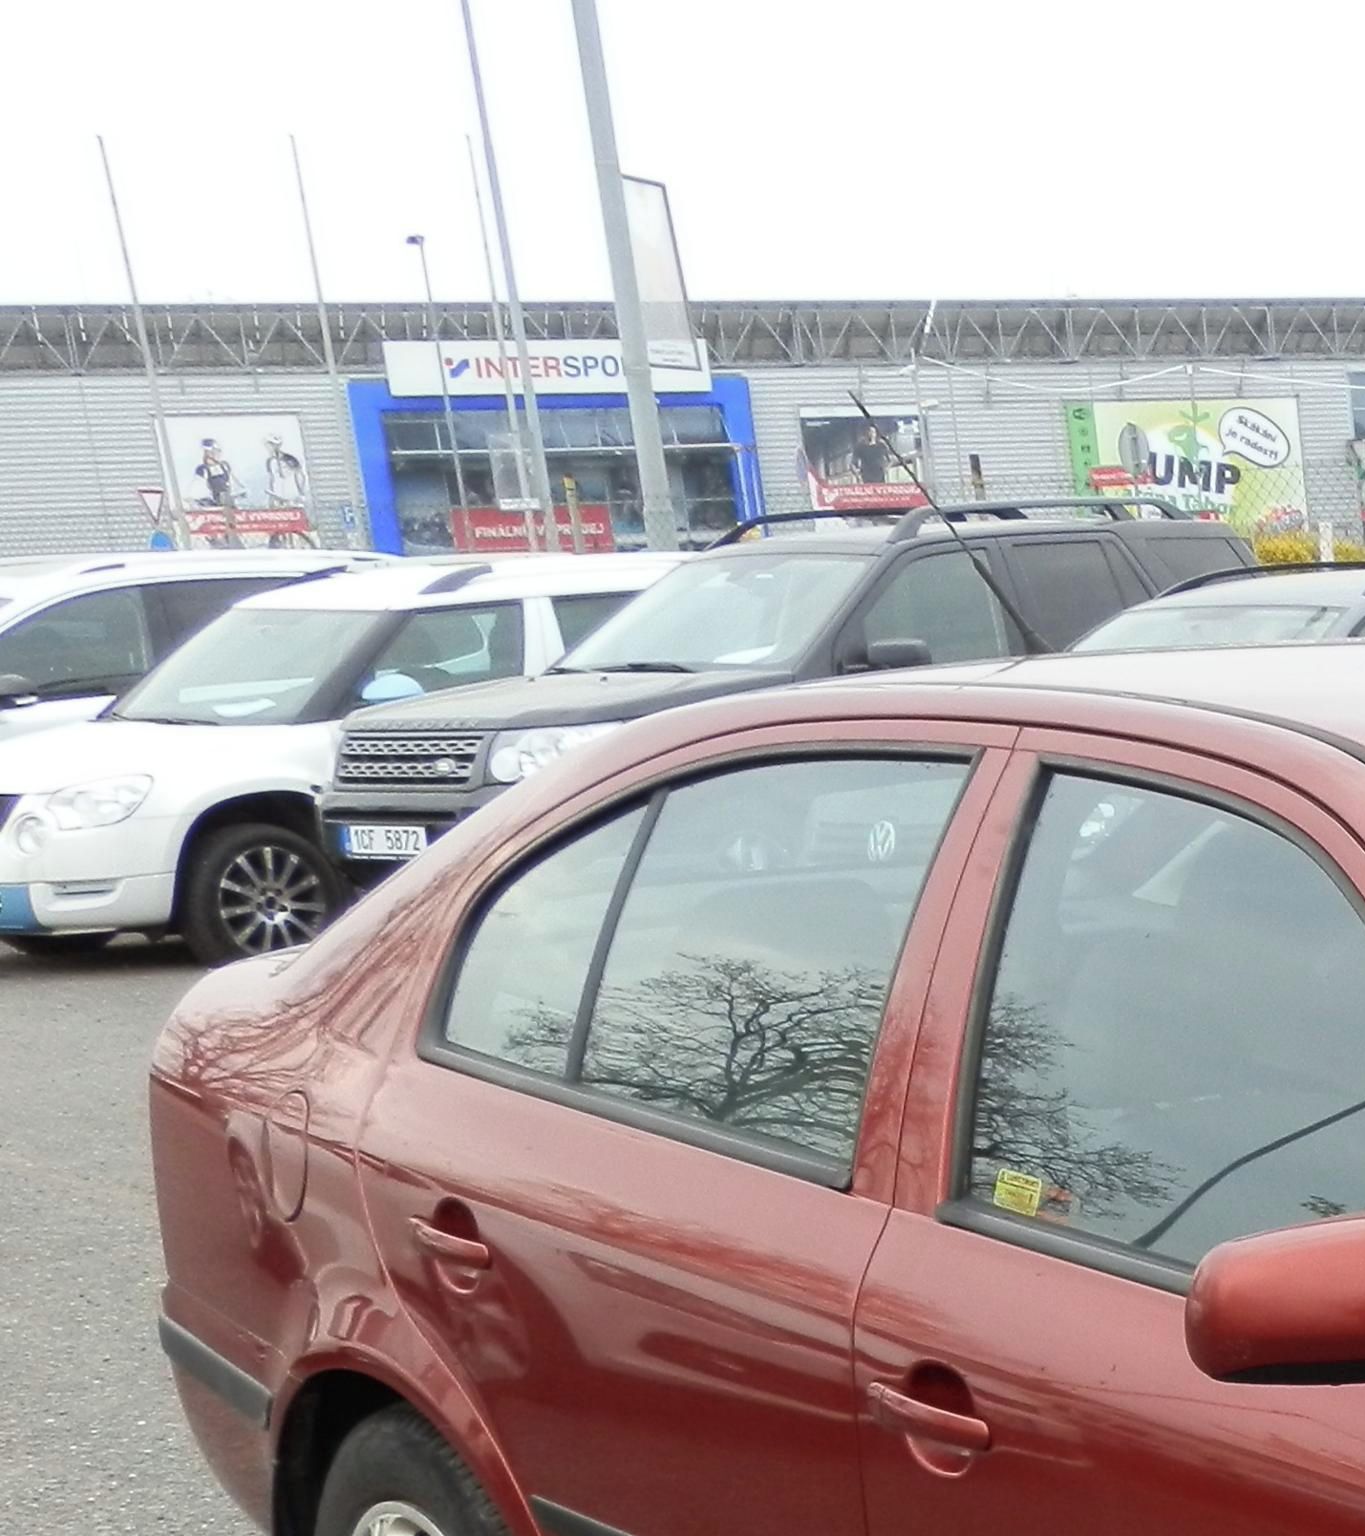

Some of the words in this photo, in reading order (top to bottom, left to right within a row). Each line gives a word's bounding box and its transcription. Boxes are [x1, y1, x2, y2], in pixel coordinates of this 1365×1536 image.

[475, 355, 625, 378] INTERSPO
[353, 829, 374, 851] 1CF
[384, 829, 421, 851] 5872
